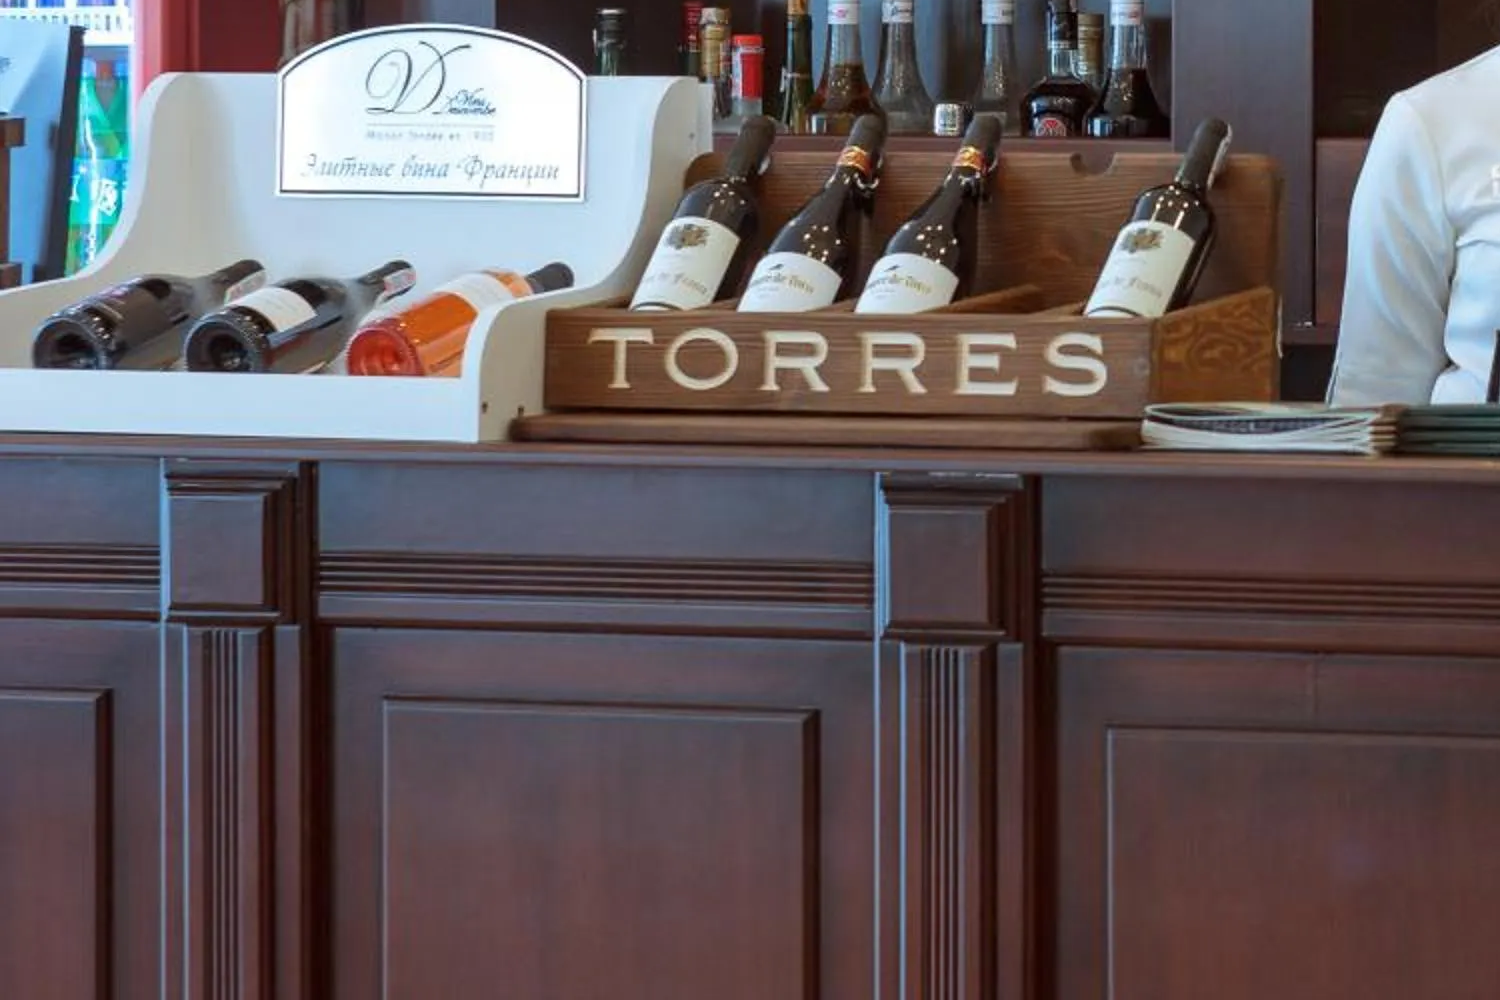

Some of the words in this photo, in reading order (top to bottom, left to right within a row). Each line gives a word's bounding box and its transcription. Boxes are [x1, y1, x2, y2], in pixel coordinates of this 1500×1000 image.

[300, 153, 396, 178] Элитные
[401, 154, 449, 180] вина
[456, 153, 560, 189] Франции
[587, 327, 1109, 397] TORRES
